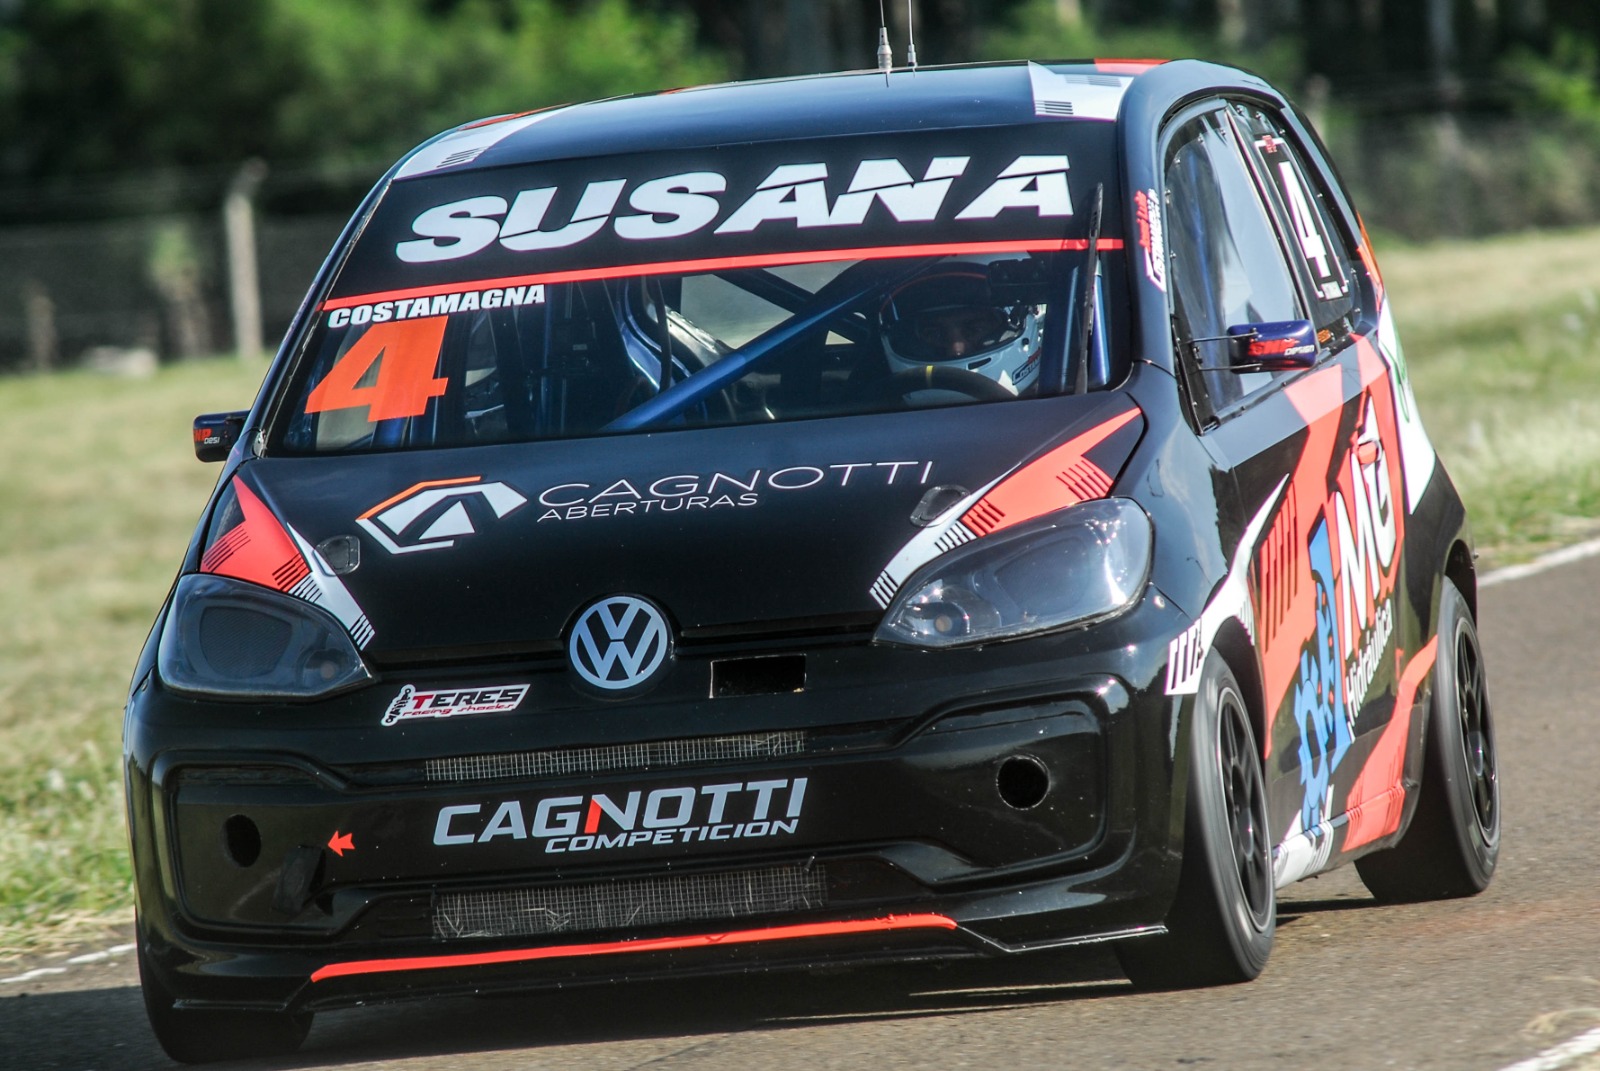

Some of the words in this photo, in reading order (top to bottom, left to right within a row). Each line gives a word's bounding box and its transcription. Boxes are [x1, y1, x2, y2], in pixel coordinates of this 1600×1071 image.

[397, 156, 1073, 263] SUSANA
[1278, 161, 1331, 278] 4
[327, 285, 546, 328] COSTAMAGNA
[304, 315, 448, 422] 4
[538, 461, 932, 505] CAGNOTTI
[537, 491, 758, 522] ABERTURAS
[1346, 598, 1393, 727] Hidráulica
[402, 707, 453, 718] racing
[457, 703, 514, 713] shocks
[412, 687, 524, 710] TERES
[432, 778, 808, 846] CAGNOTTI
[545, 818, 799, 854] COMPETICION
